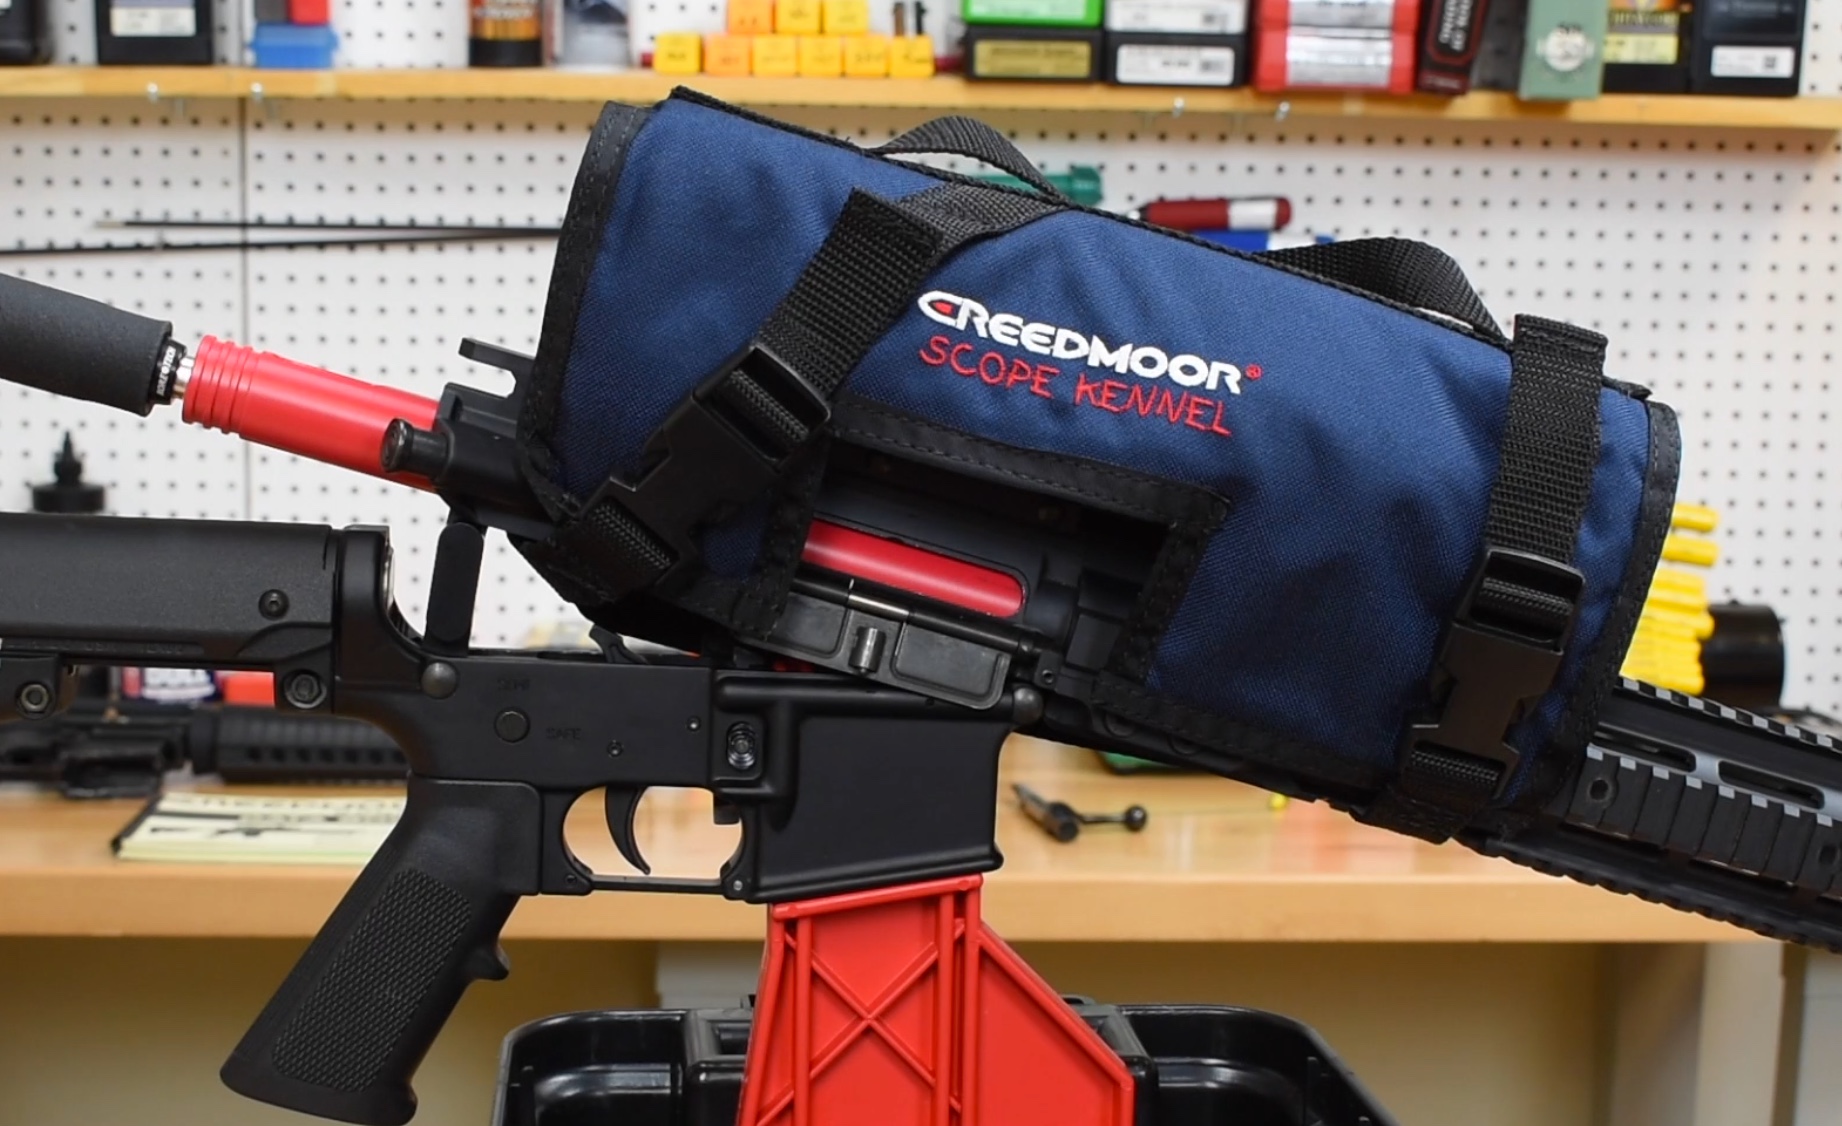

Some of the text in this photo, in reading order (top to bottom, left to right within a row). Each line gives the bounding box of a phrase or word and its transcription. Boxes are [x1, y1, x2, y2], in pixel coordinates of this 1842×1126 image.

[917, 290, 1262, 394] CREEDMOOR®
[919, 335, 1231, 437] SCOPE KENNEL
[545, 727, 582, 741] SAFE
